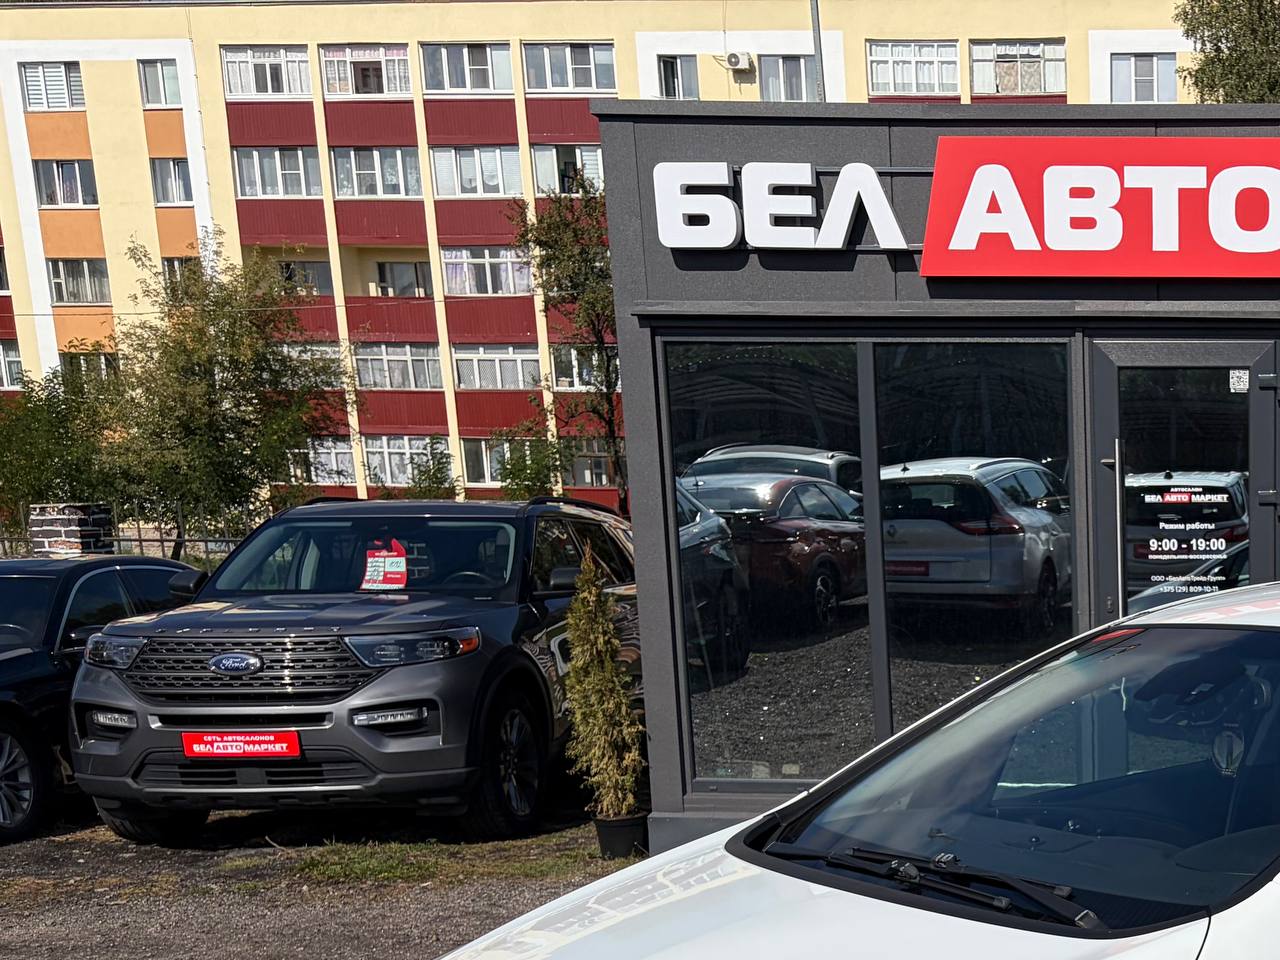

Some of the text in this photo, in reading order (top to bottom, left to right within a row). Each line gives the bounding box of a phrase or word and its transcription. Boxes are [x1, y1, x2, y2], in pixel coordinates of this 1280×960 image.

[653, 161, 909, 249] БЕЛ
[1144, 494, 1229, 503] БЕЛ АВТО МАРКЕТ
[1159, 522, 1215, 531] Режим работы
[1149, 538, 1178, 551] 9:00
[1190, 538, 1226, 551] 19:00
[220, 657, 249, 669] Ford
[193, 743, 288, 752] БЕЛ АВТО МАРКЕТ
